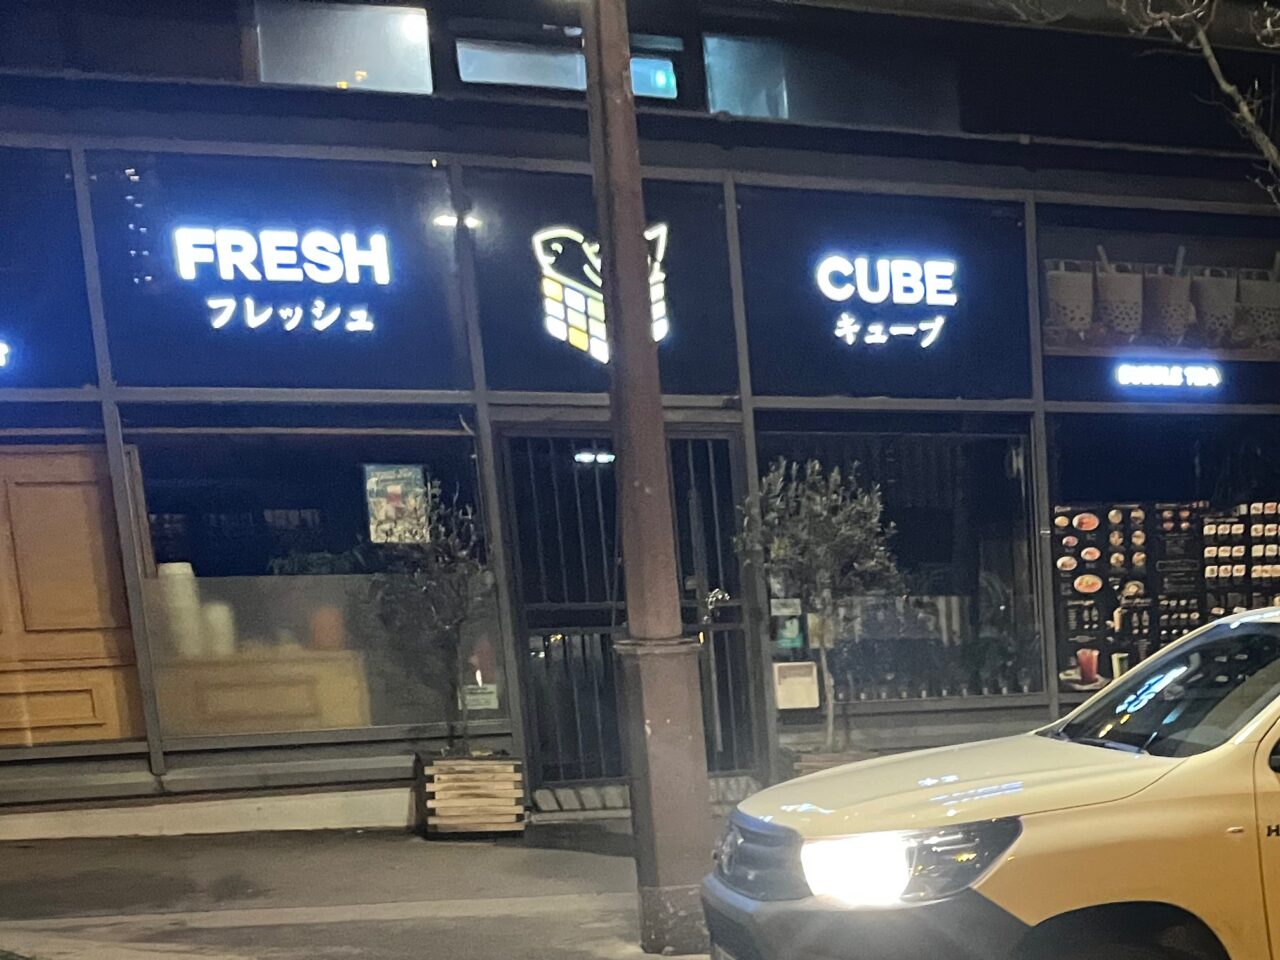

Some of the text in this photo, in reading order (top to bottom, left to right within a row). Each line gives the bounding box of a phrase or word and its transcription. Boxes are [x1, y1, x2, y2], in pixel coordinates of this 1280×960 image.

[172, 226, 391, 285] FRESH
[815, 254, 957, 306] CUBE
[206, 296, 375, 332] フレッシュ
